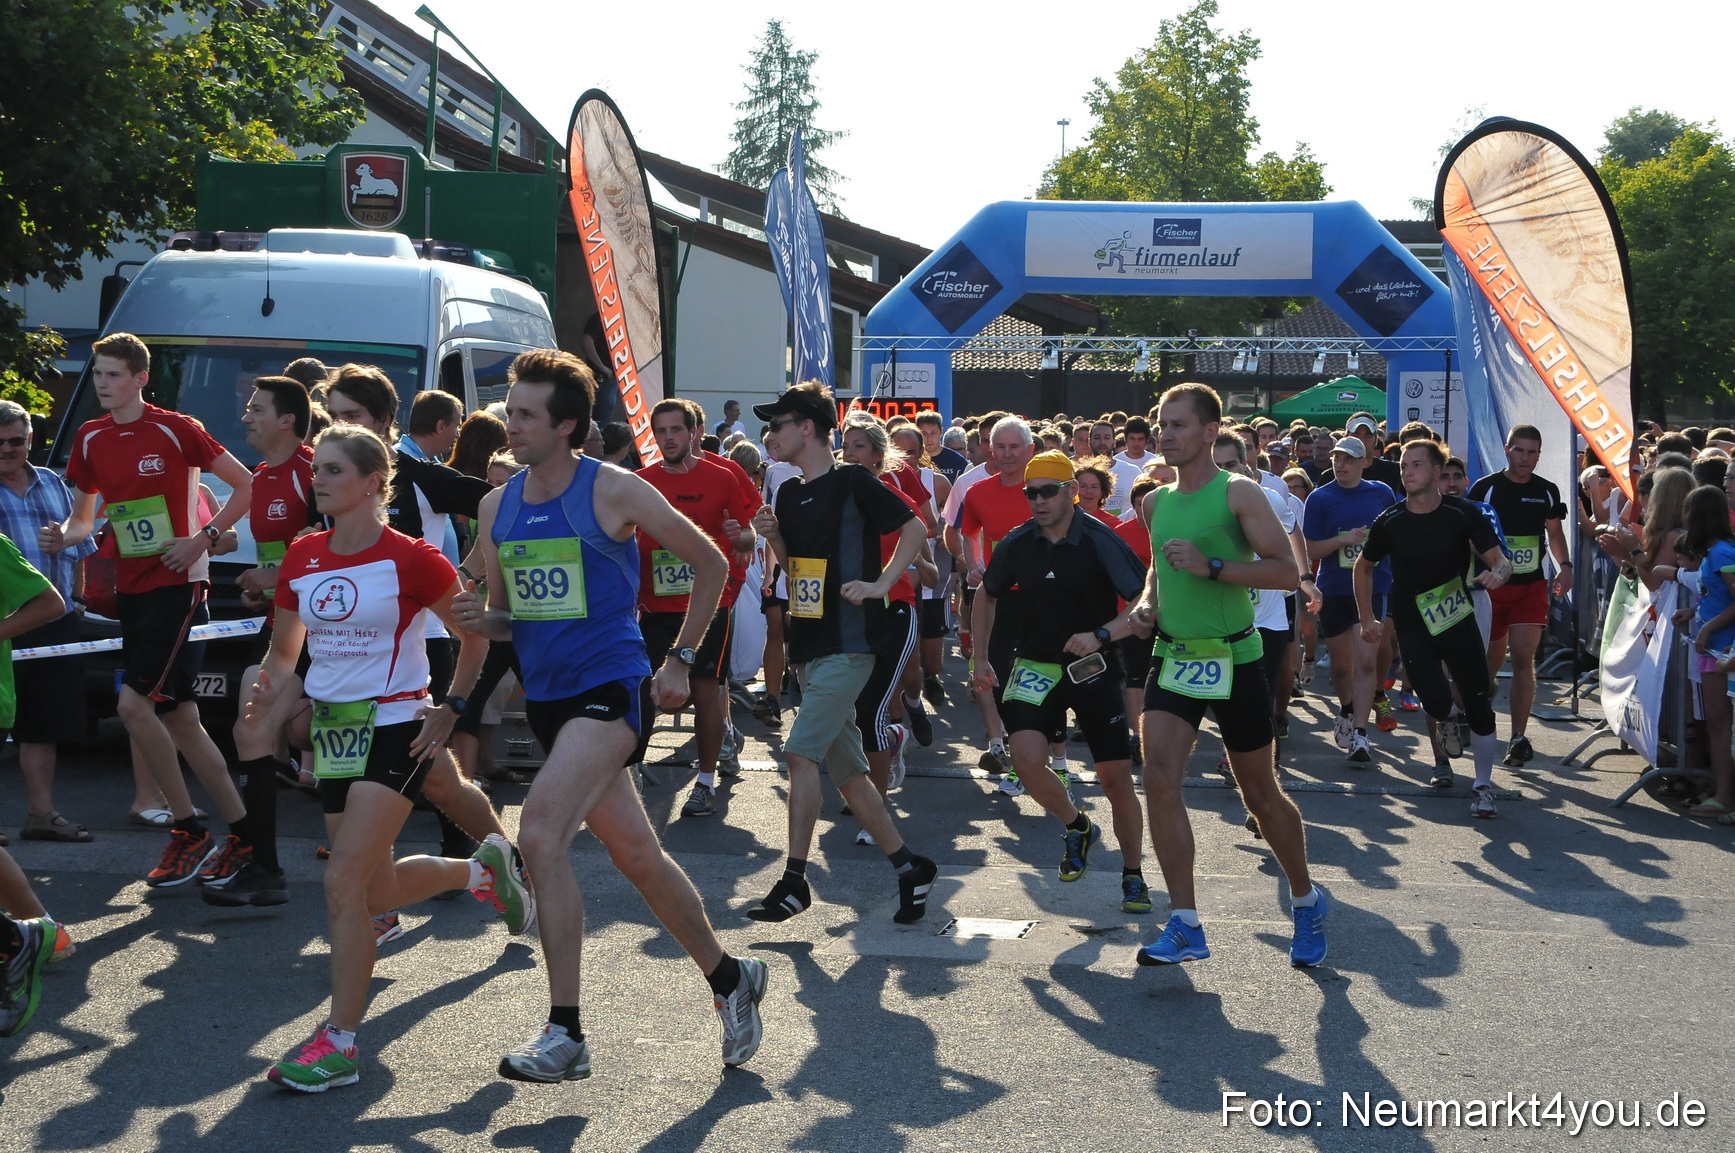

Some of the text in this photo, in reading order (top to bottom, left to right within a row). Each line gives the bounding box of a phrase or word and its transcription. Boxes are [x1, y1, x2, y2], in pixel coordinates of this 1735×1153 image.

[361, 211, 389, 222] 1628
[1163, 228, 1198, 237] Fischer
[1135, 247, 1242, 266] firmenlauf
[932, 280, 989, 293] Fischer
[1355, 284, 1371, 294] und
[1373, 282, 1388, 291] das
[1375, 291, 1398, 302] fährt
[126, 519, 154, 543] 19
[1508, 549, 1523, 565] 69
[514, 567, 570, 600] 589
[1424, 589, 1466, 624] 1124
[1173, 660, 1222, 685] 729
[313, 727, 371, 758] 1026
